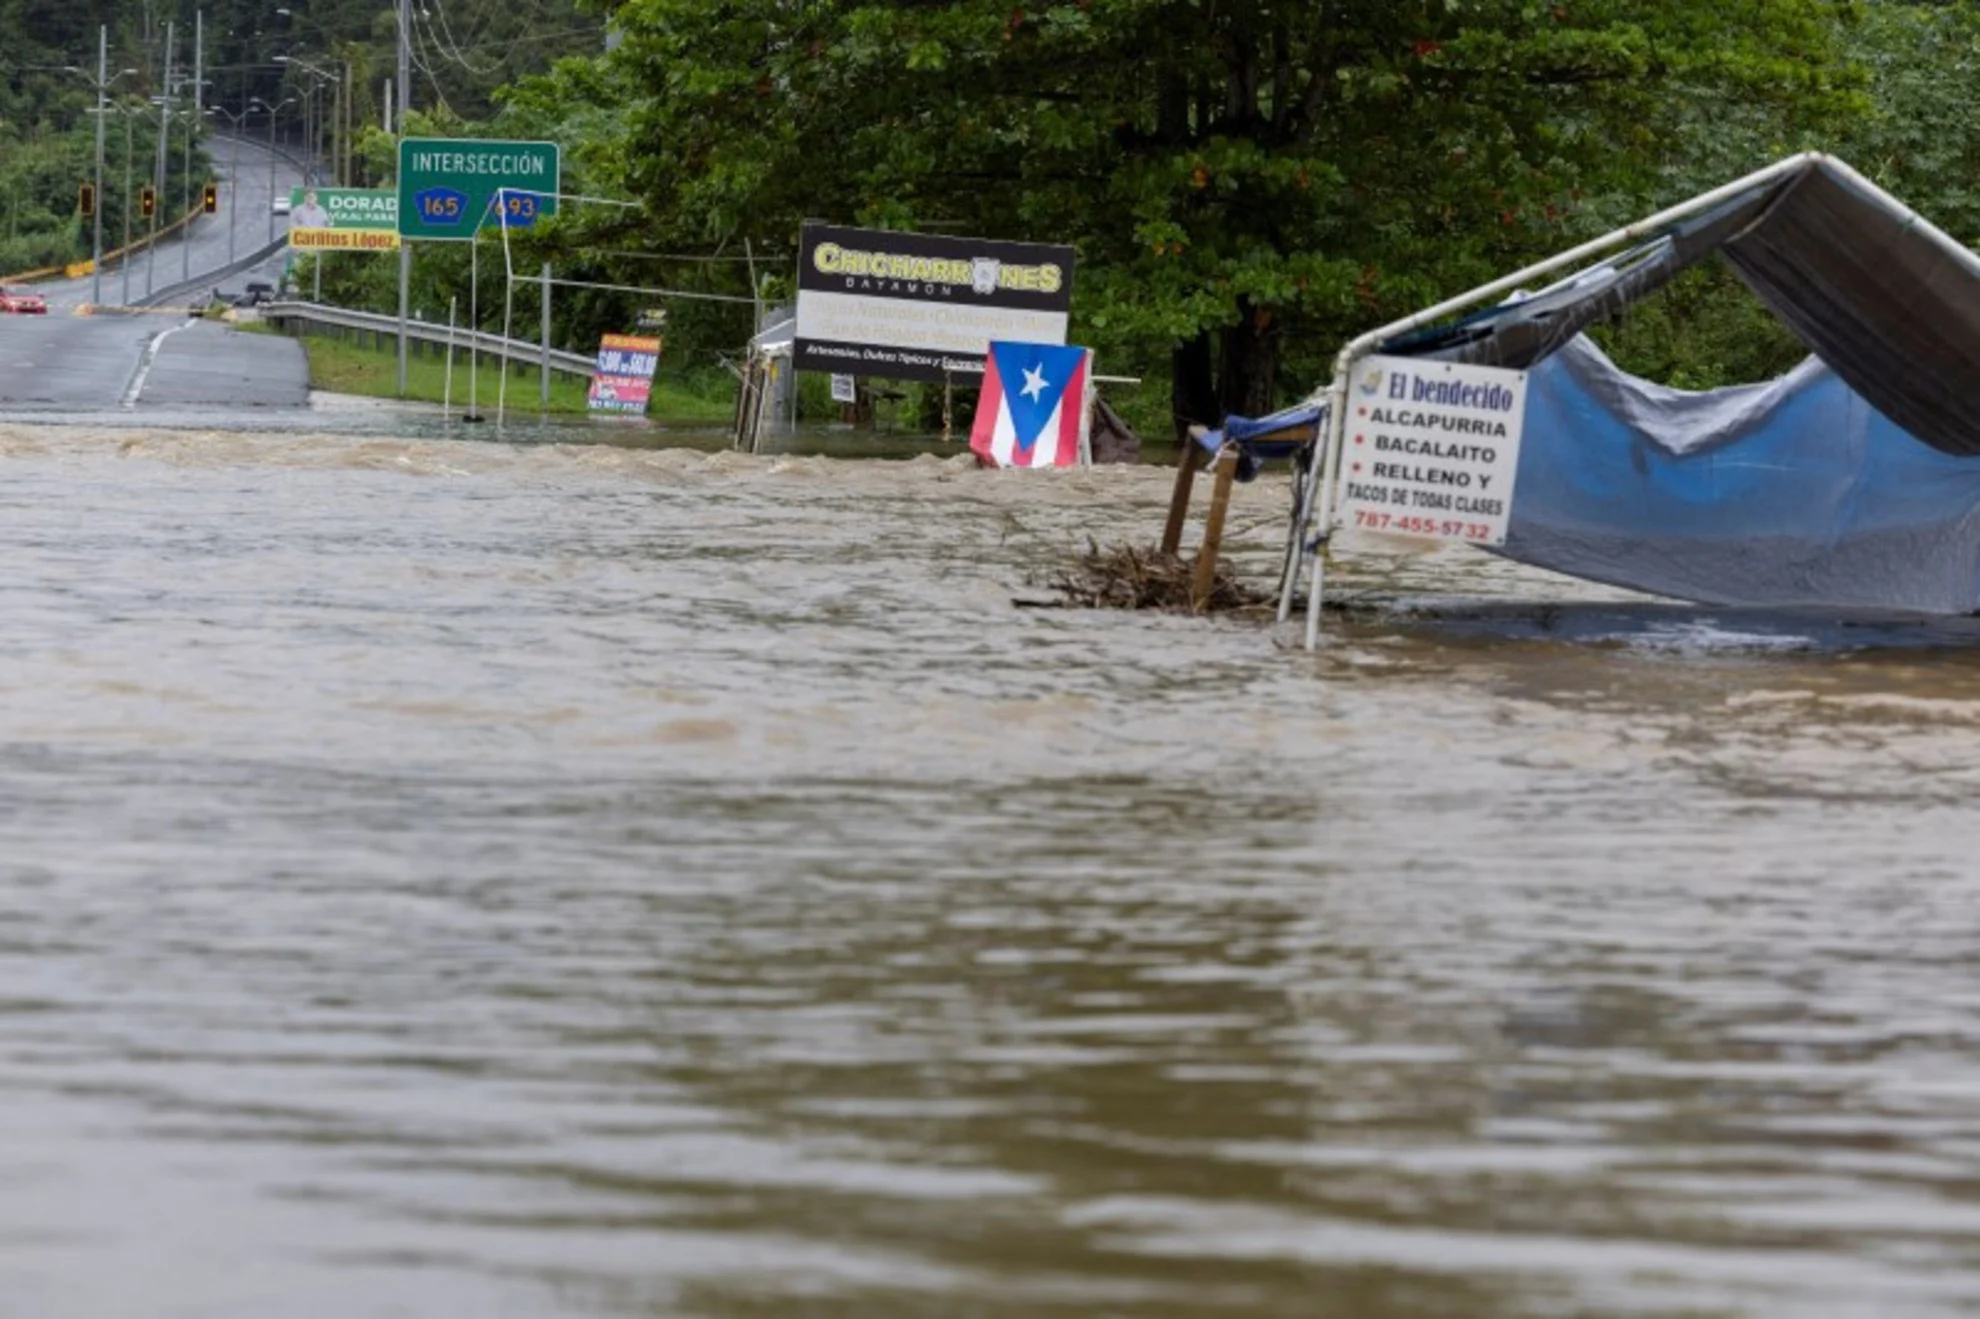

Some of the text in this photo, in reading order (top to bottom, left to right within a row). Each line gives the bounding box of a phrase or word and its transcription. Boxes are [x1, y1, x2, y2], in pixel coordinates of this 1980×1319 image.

[411, 151, 545, 175] INTERSECCIÓN
[424, 196, 459, 216] 165
[353, 230, 394, 248] López
[1388, 371, 1513, 412] El bendecido
[1370, 407, 1507, 438] ALCAPURRIA
[1374, 434, 1496, 464] BACALAITO
[1373, 461, 1491, 490] RELLENO Y
[1347, 481, 1504, 516] TACOS DE TODAS CLASES
